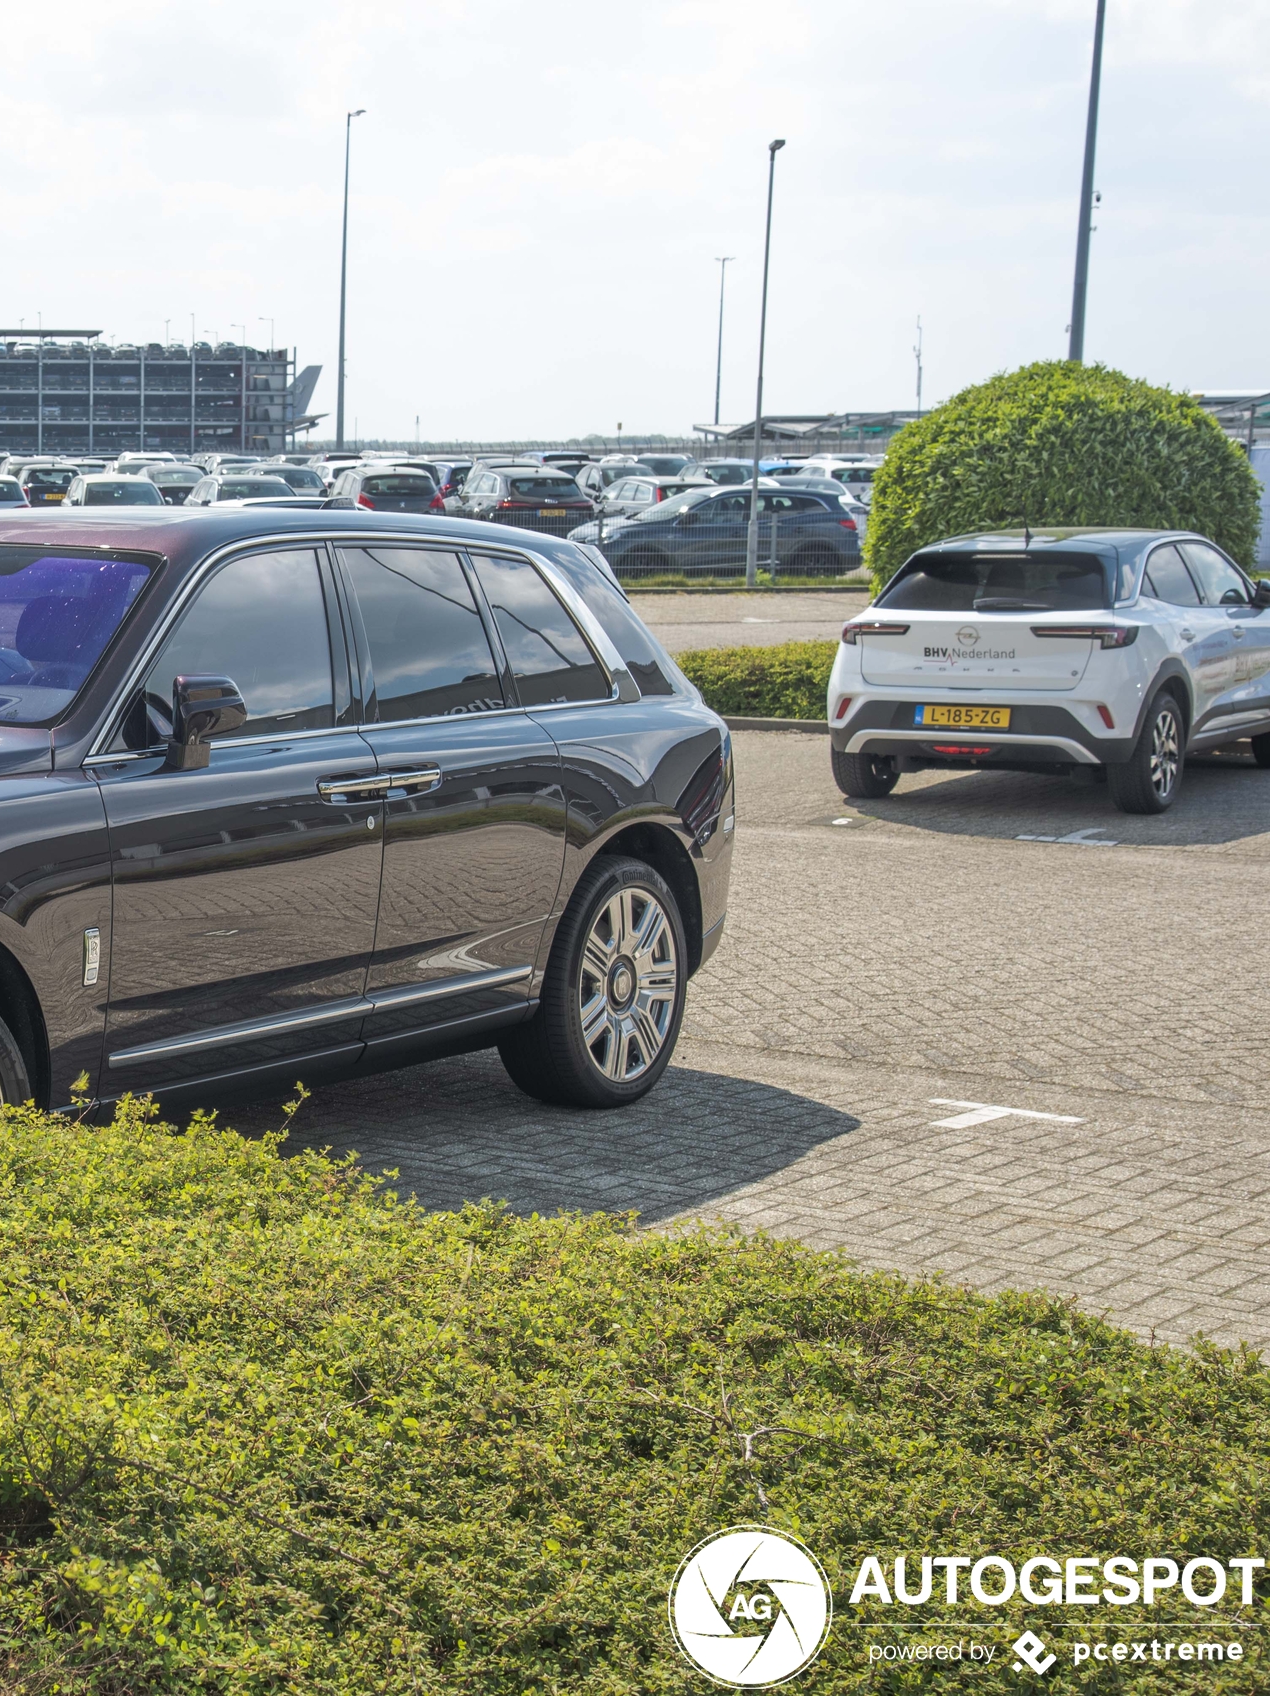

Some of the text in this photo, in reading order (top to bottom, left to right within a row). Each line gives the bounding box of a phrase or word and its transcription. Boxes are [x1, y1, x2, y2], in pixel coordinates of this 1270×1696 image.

[924, 647, 1016, 659] BHV Nederland
[931, 708, 1001, 724] L-185-ZG
